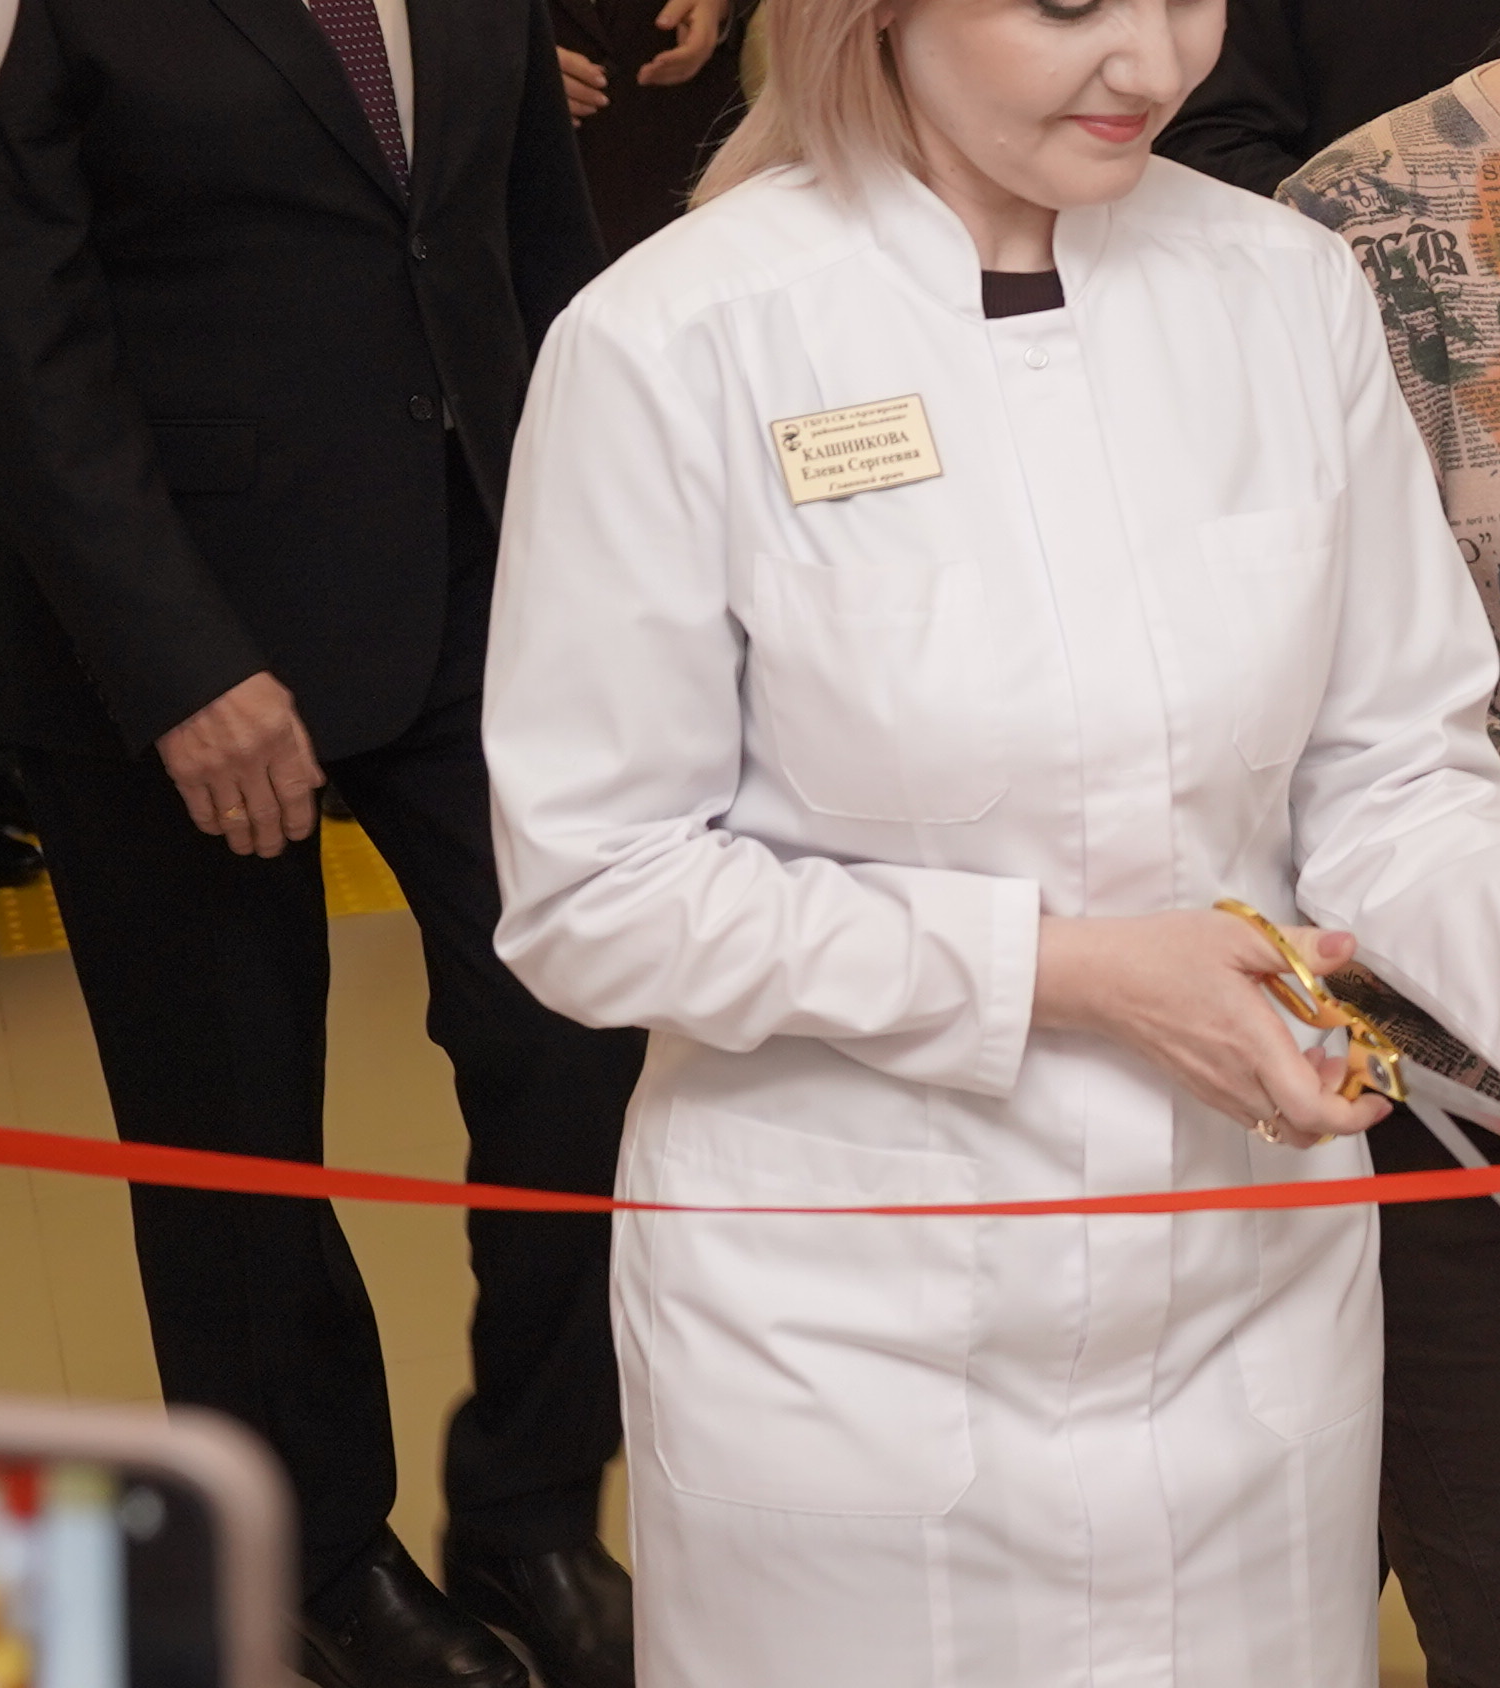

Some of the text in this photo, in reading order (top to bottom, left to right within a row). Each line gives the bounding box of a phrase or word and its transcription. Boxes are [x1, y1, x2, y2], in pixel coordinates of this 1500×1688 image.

[802, 430, 910, 462] КАШНИКОВА
[801, 448, 921, 482] Елена Сергеевна
